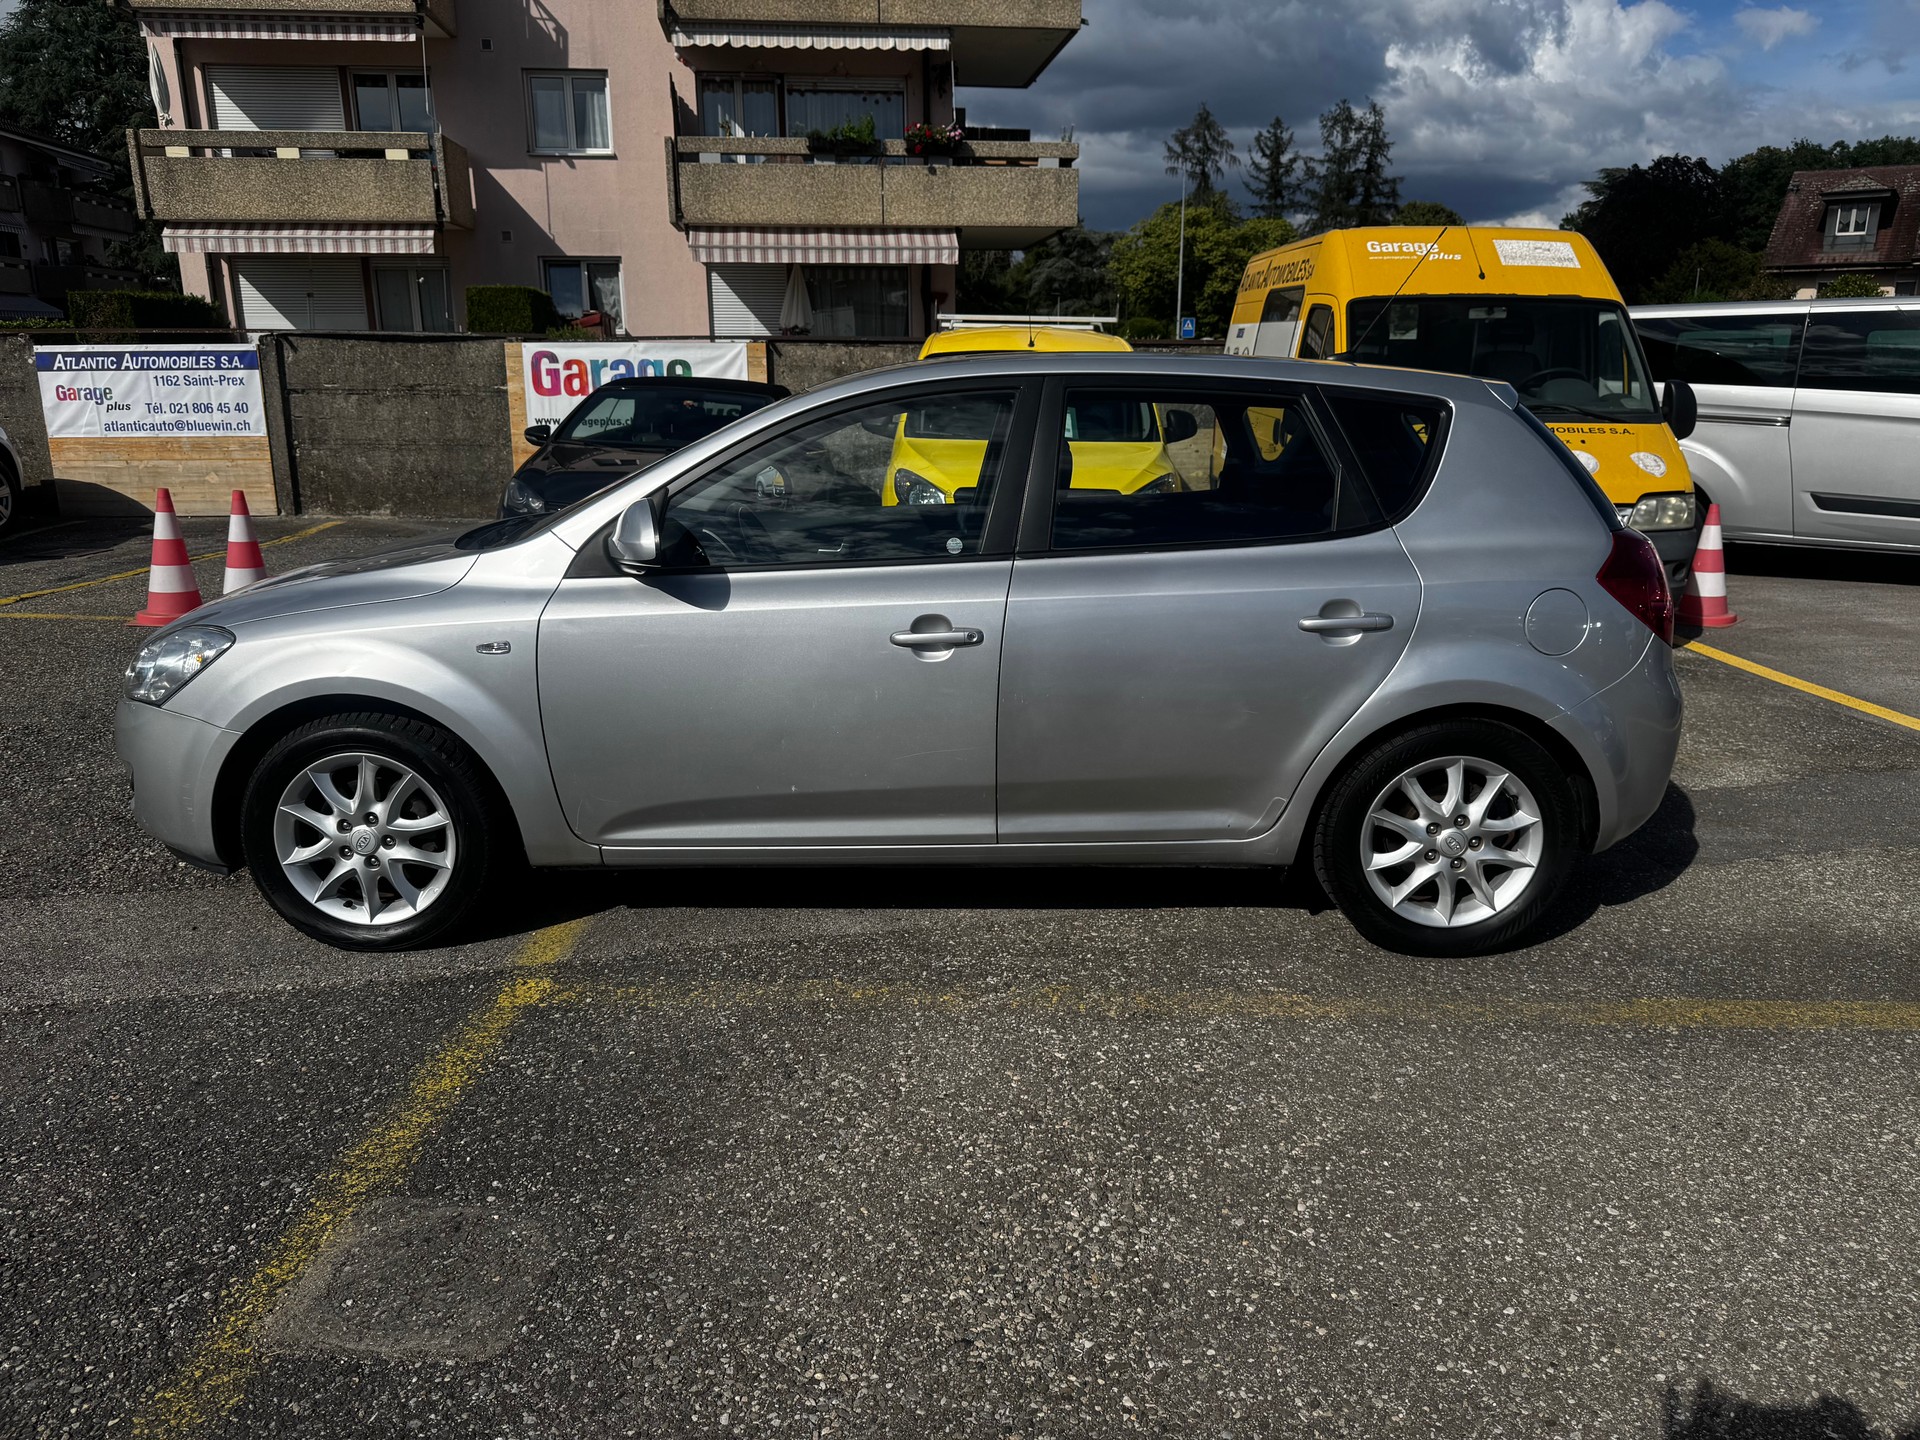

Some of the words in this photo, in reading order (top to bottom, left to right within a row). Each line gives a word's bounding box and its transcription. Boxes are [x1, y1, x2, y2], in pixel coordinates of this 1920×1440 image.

[1366, 241, 1440, 255] Garage
[1429, 252, 1462, 261] plus
[1261, 258, 1310, 288] AUTOMOBILES
[53, 353, 117, 371] ATLANTIC
[120, 353, 216, 370] AUTOMOBILES
[220, 356, 245, 369] S.A.
[153, 374, 181, 387] 1162
[183, 374, 246, 387] Saint-Prex
[55, 384, 113, 405] Garage
[106, 401, 131, 413] plus
[145, 402, 167, 415] Tél.
[169, 402, 190, 415] 021
[192, 402, 214, 414] 806
[217, 402, 231, 414] 45
[234, 402, 249, 414] 40
[103, 419, 251, 432] atlanticauto@bluewin.ch
[1609, 427, 1635, 435] S.A.
